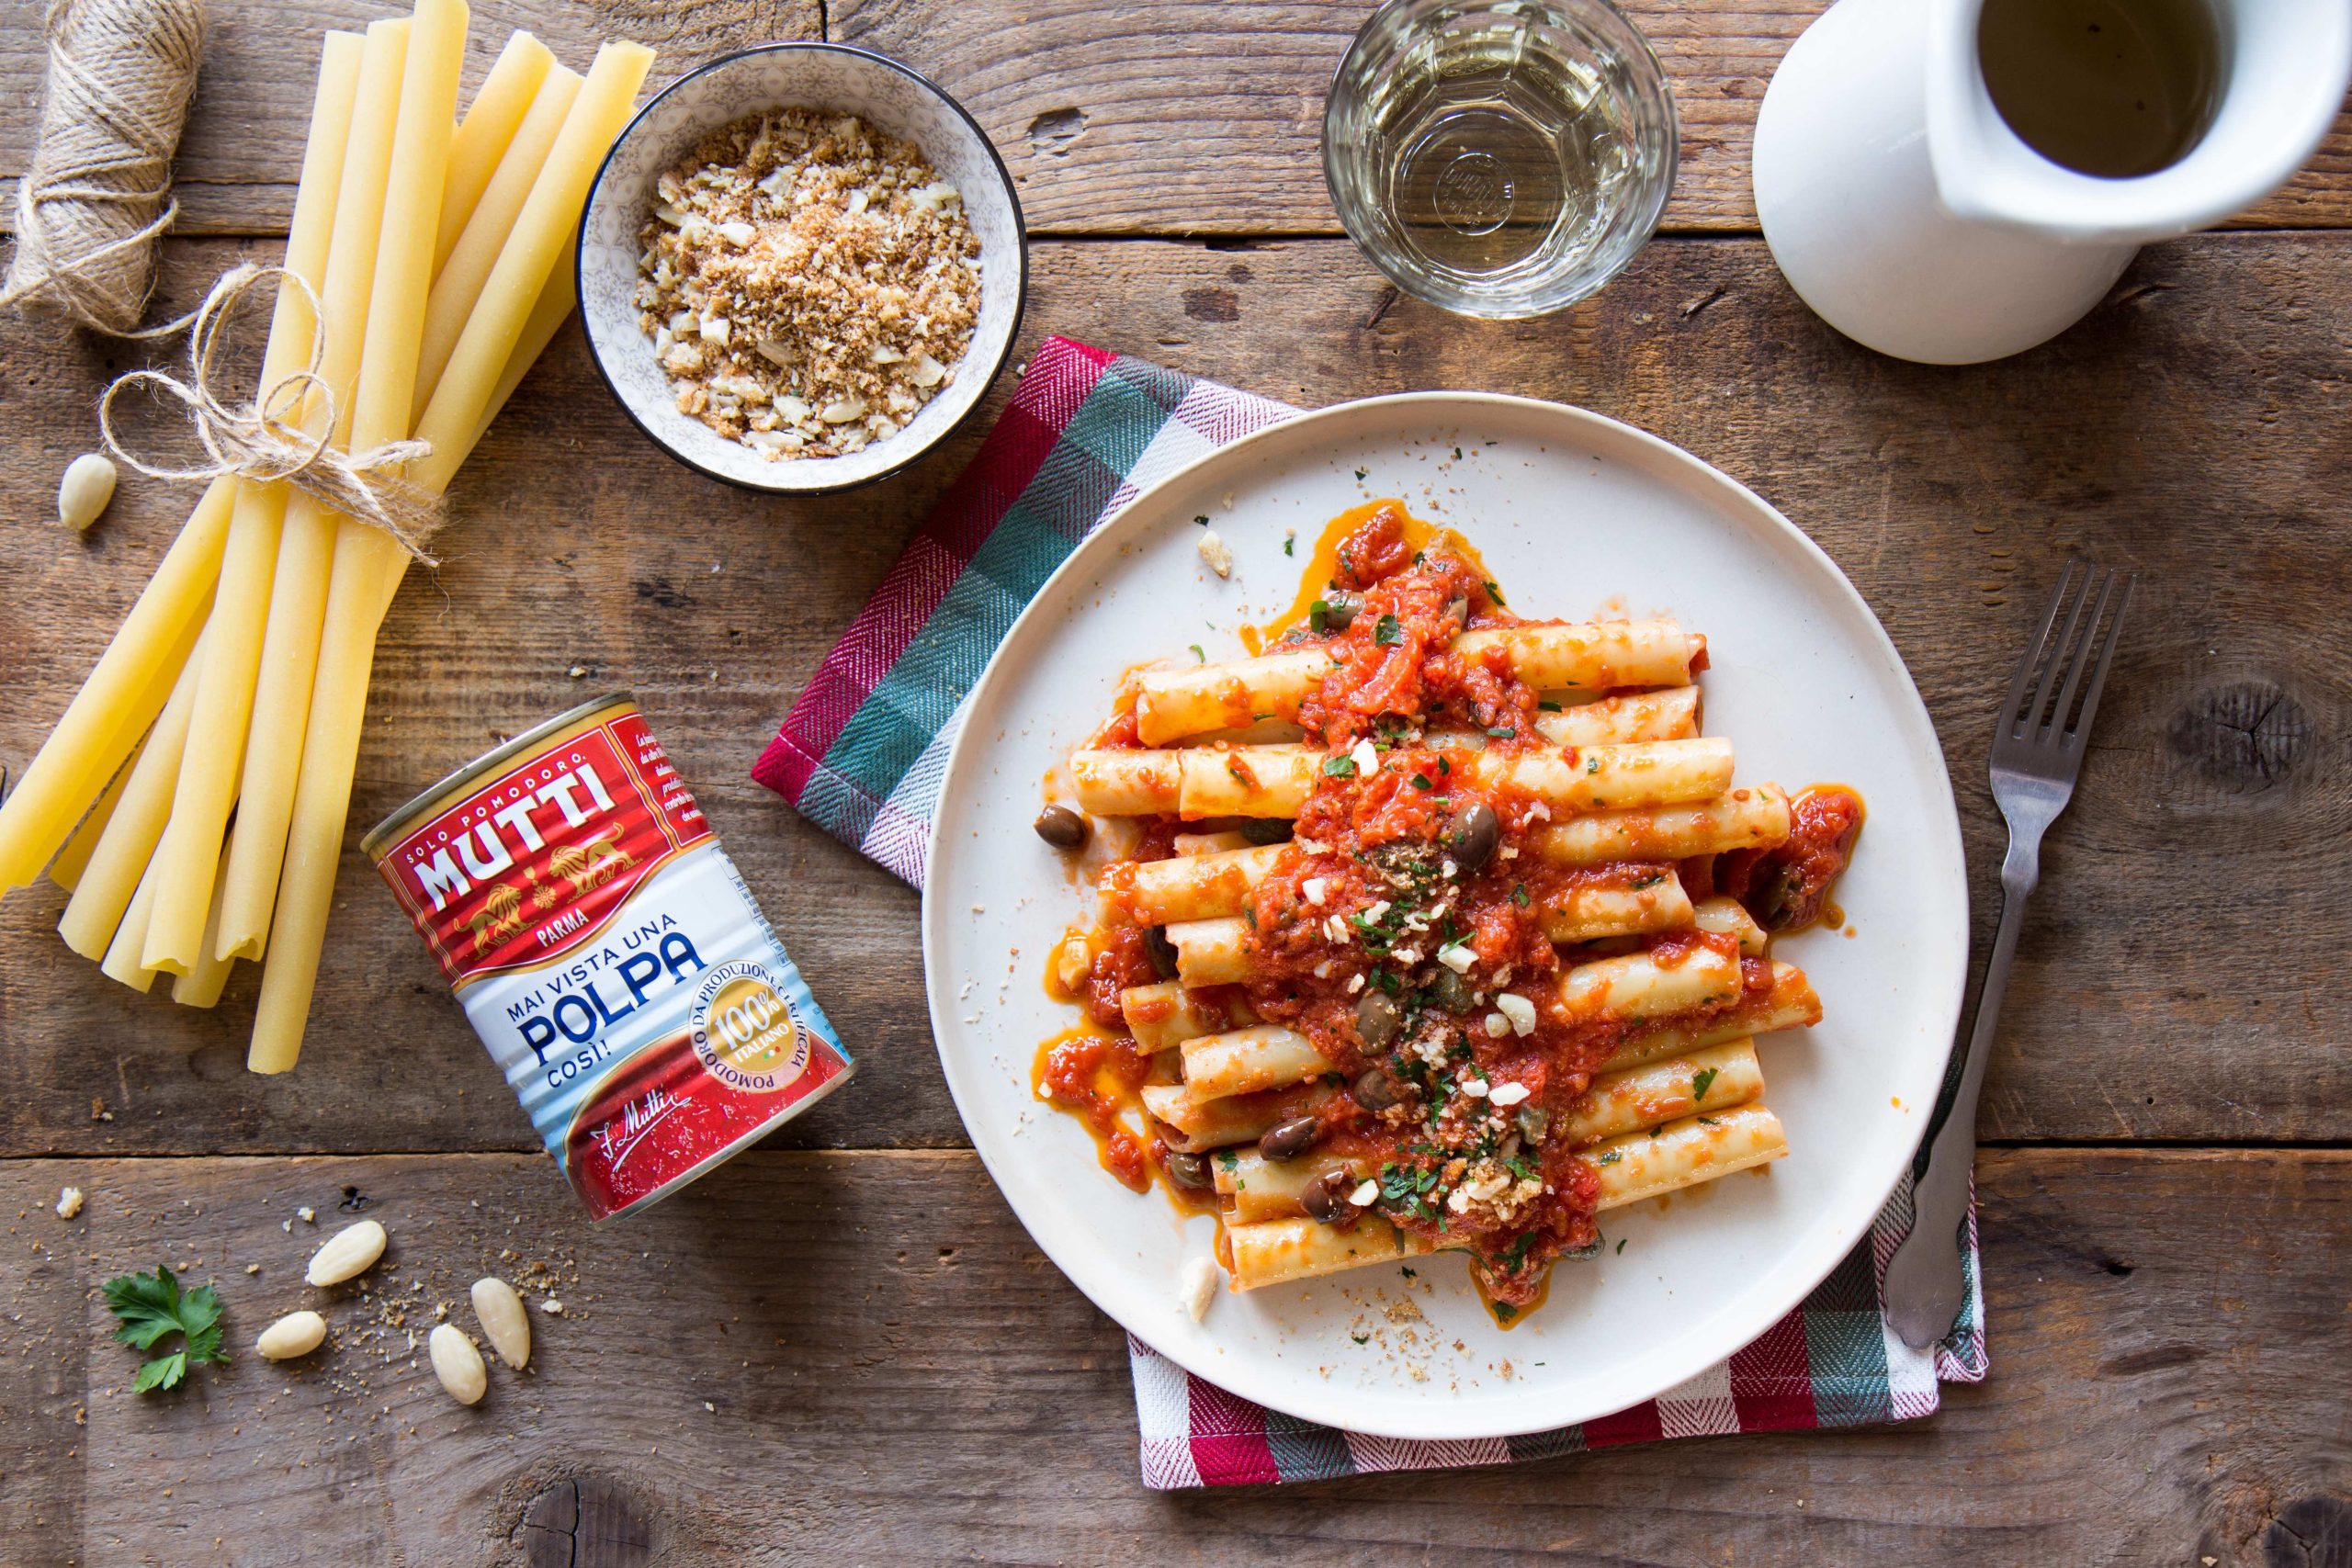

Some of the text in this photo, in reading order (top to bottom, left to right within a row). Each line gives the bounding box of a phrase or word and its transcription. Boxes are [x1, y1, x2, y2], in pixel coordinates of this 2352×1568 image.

[406, 752, 586, 863] SOLO POMODORO.
[413, 762, 618, 912] MUTTI
[537, 908, 589, 948] PARMA
[506, 913, 677, 1021] MAI VISTA UNA
[699, 963, 777, 1002] PRODUZIONE
[516, 931, 708, 1067] POLPA
[693, 1004, 707, 1026] DA
[715, 988, 781, 1051] 100%
[777, 987, 808, 1067] CERTIFICATA
[548, 1039, 612, 1089] COSÌ!
[694, 1031, 775, 1089] POMODORO
[733, 1022, 789, 1063] ITALIANO
[616, 1089, 689, 1147] Mutti
